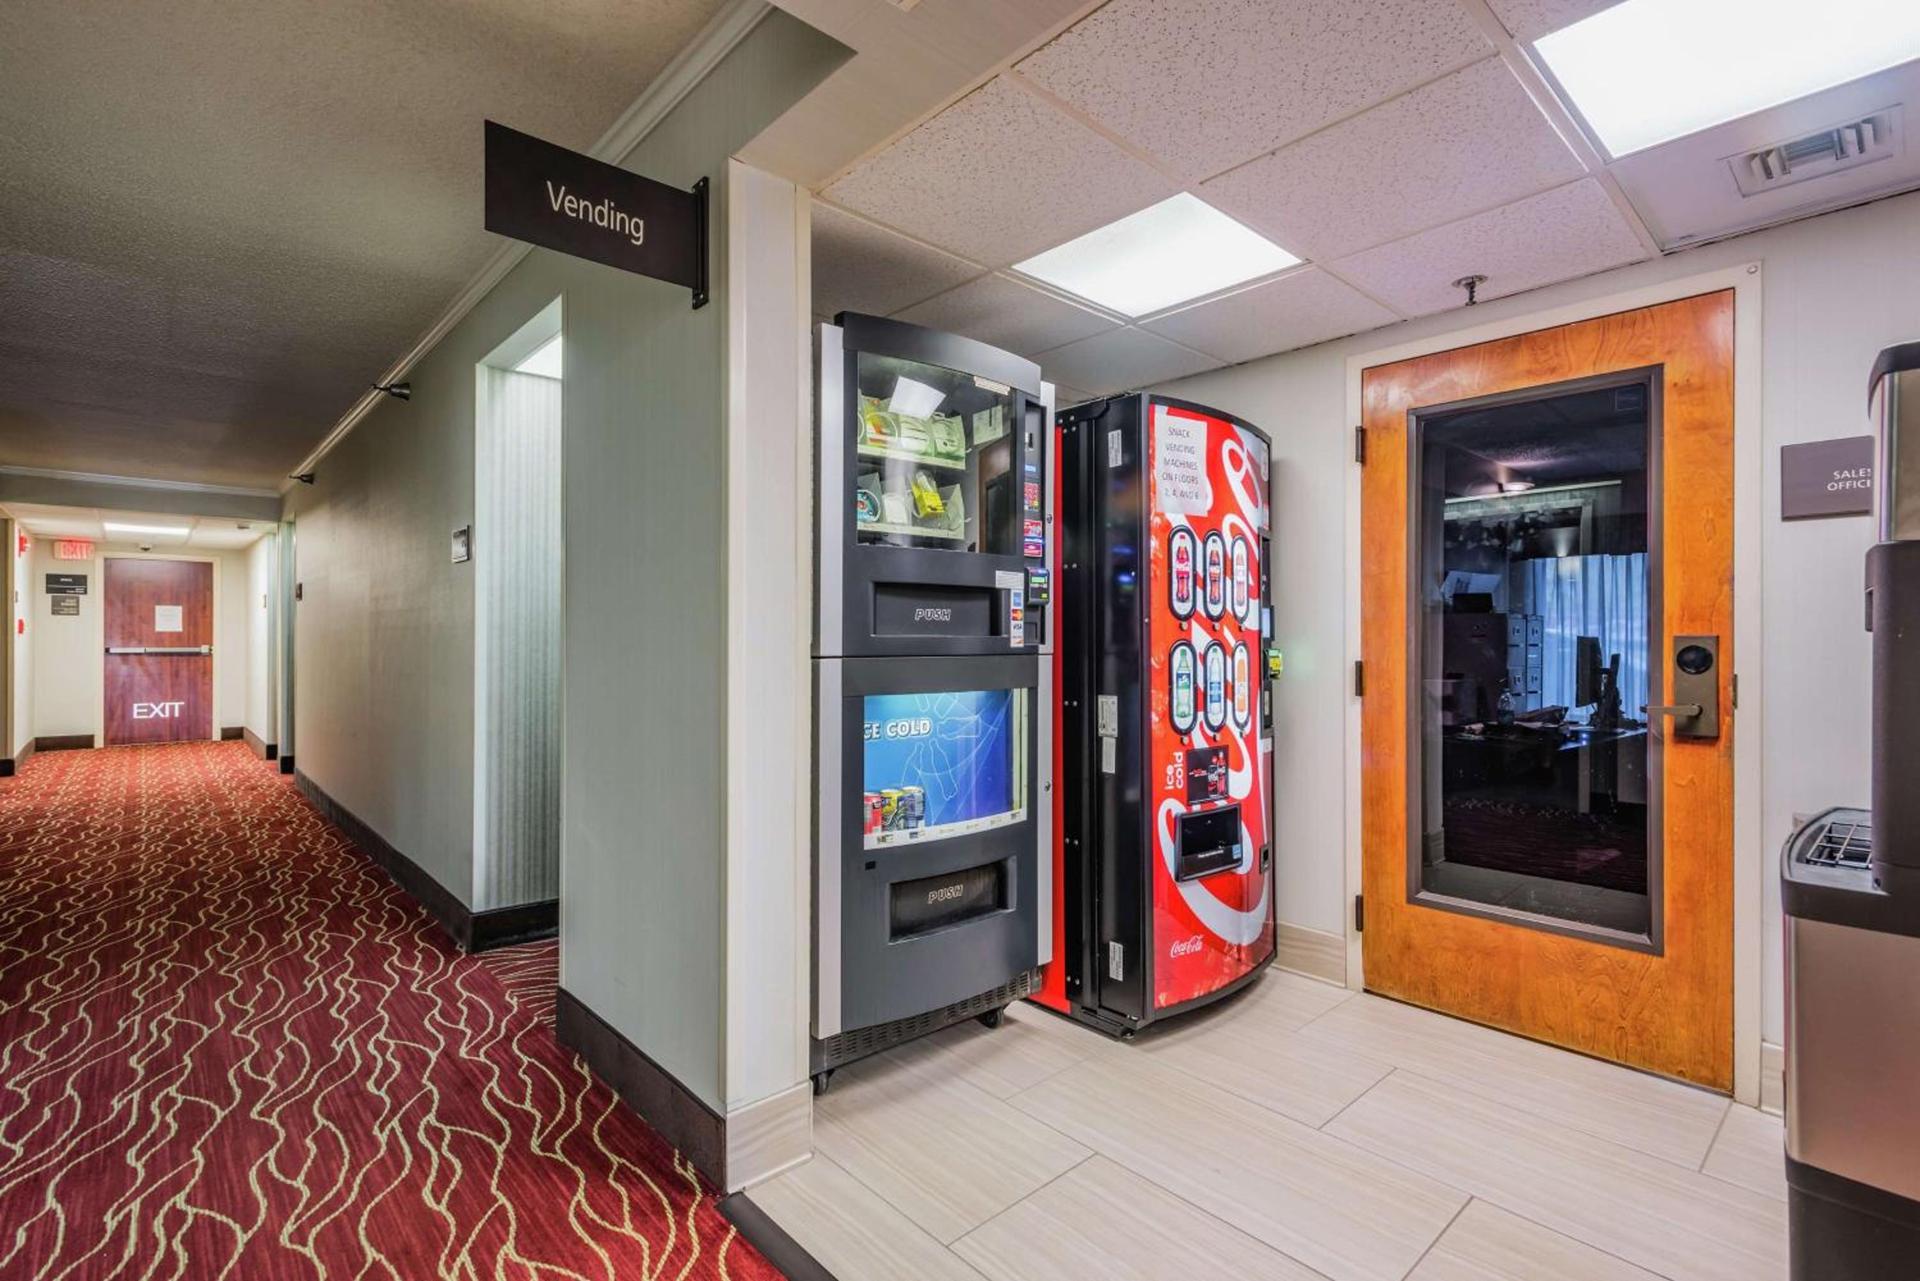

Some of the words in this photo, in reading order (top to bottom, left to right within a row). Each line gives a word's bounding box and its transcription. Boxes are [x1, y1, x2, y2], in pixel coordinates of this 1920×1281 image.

[546, 180, 645, 246] Vending
[1168, 426, 1190, 438] SNACK
[1165, 442, 1195, 455] VENDING
[1163, 457, 1198, 471] MACHINES
[1162, 471, 1173, 481] ON
[1174, 473, 1199, 485] FLOORS
[61, 542, 91, 560] EXIT
[914, 608, 952, 621] PUSH
[132, 702, 185, 719] EXIT
[886, 718, 932, 738] COLD
[1165, 764, 1175, 790] Ice
[1173, 752, 1184, 789] cold
[927, 884, 964, 904] PUSH
[1170, 935, 1203, 958] Coca-Cola
